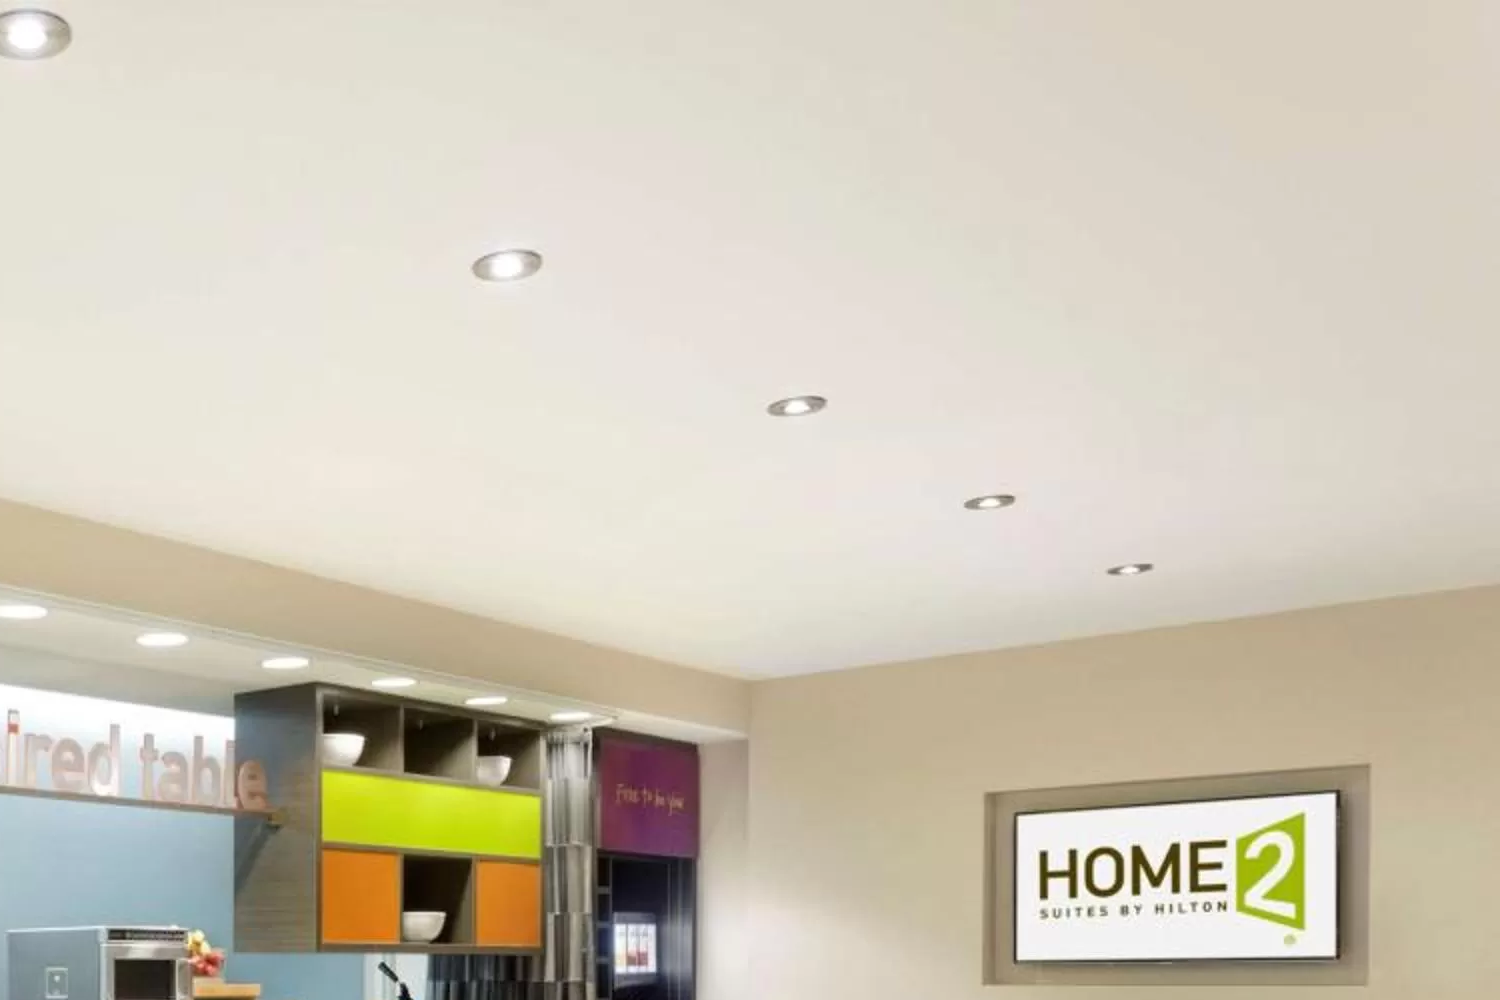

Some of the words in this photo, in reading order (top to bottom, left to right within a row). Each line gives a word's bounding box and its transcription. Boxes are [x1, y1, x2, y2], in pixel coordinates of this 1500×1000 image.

[1039, 839, 1228, 900] HOME
[1243, 829, 1297, 921] 2
[1039, 904, 1110, 920] SUITES
[1120, 902, 1143, 917] BY
[1155, 900, 1228, 915] HILTON
